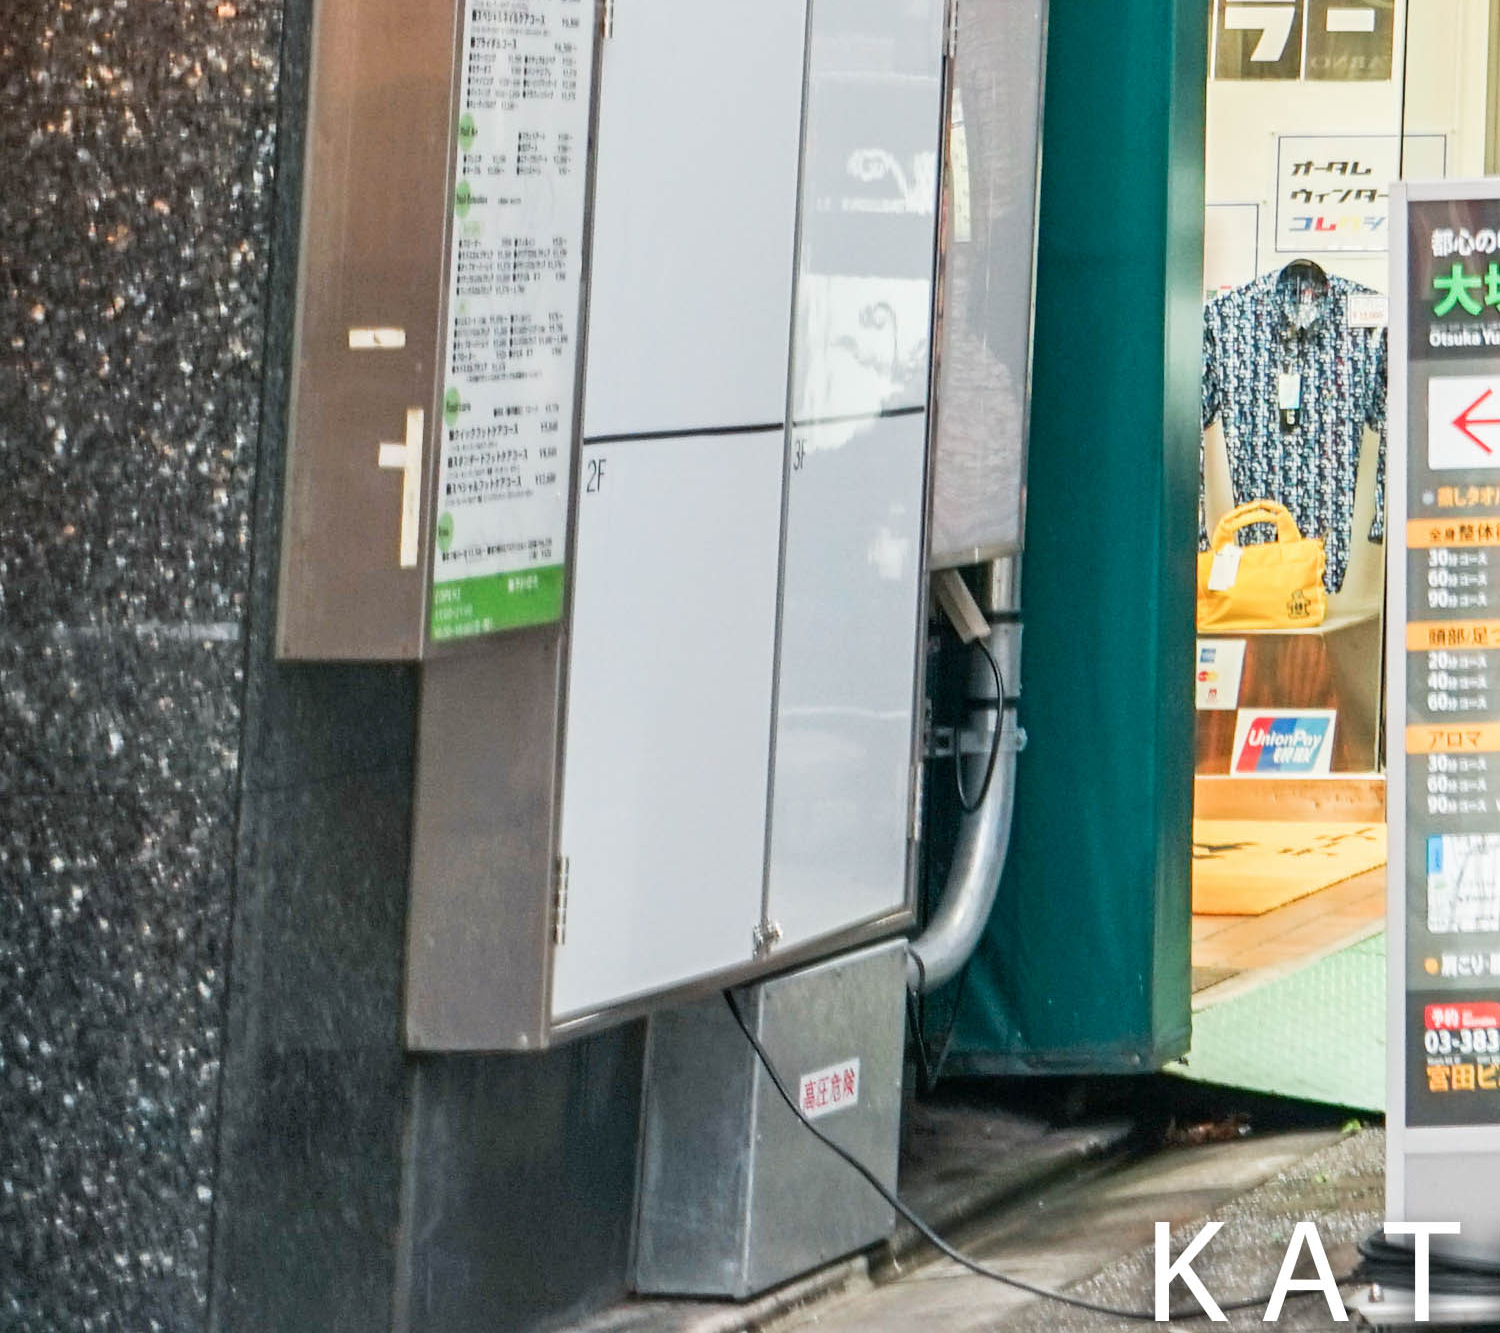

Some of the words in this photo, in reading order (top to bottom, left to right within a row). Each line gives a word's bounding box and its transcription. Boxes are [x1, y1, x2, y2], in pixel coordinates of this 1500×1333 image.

[1291, 159, 1373, 178] オータム
[1428, 330, 1480, 348] Otsuka
[793, 439, 807, 472] 3F
[586, 458, 607, 494] 2F
[1247, 727, 1324, 753] UnionPay
[1429, 730, 1482, 749] アロマ
